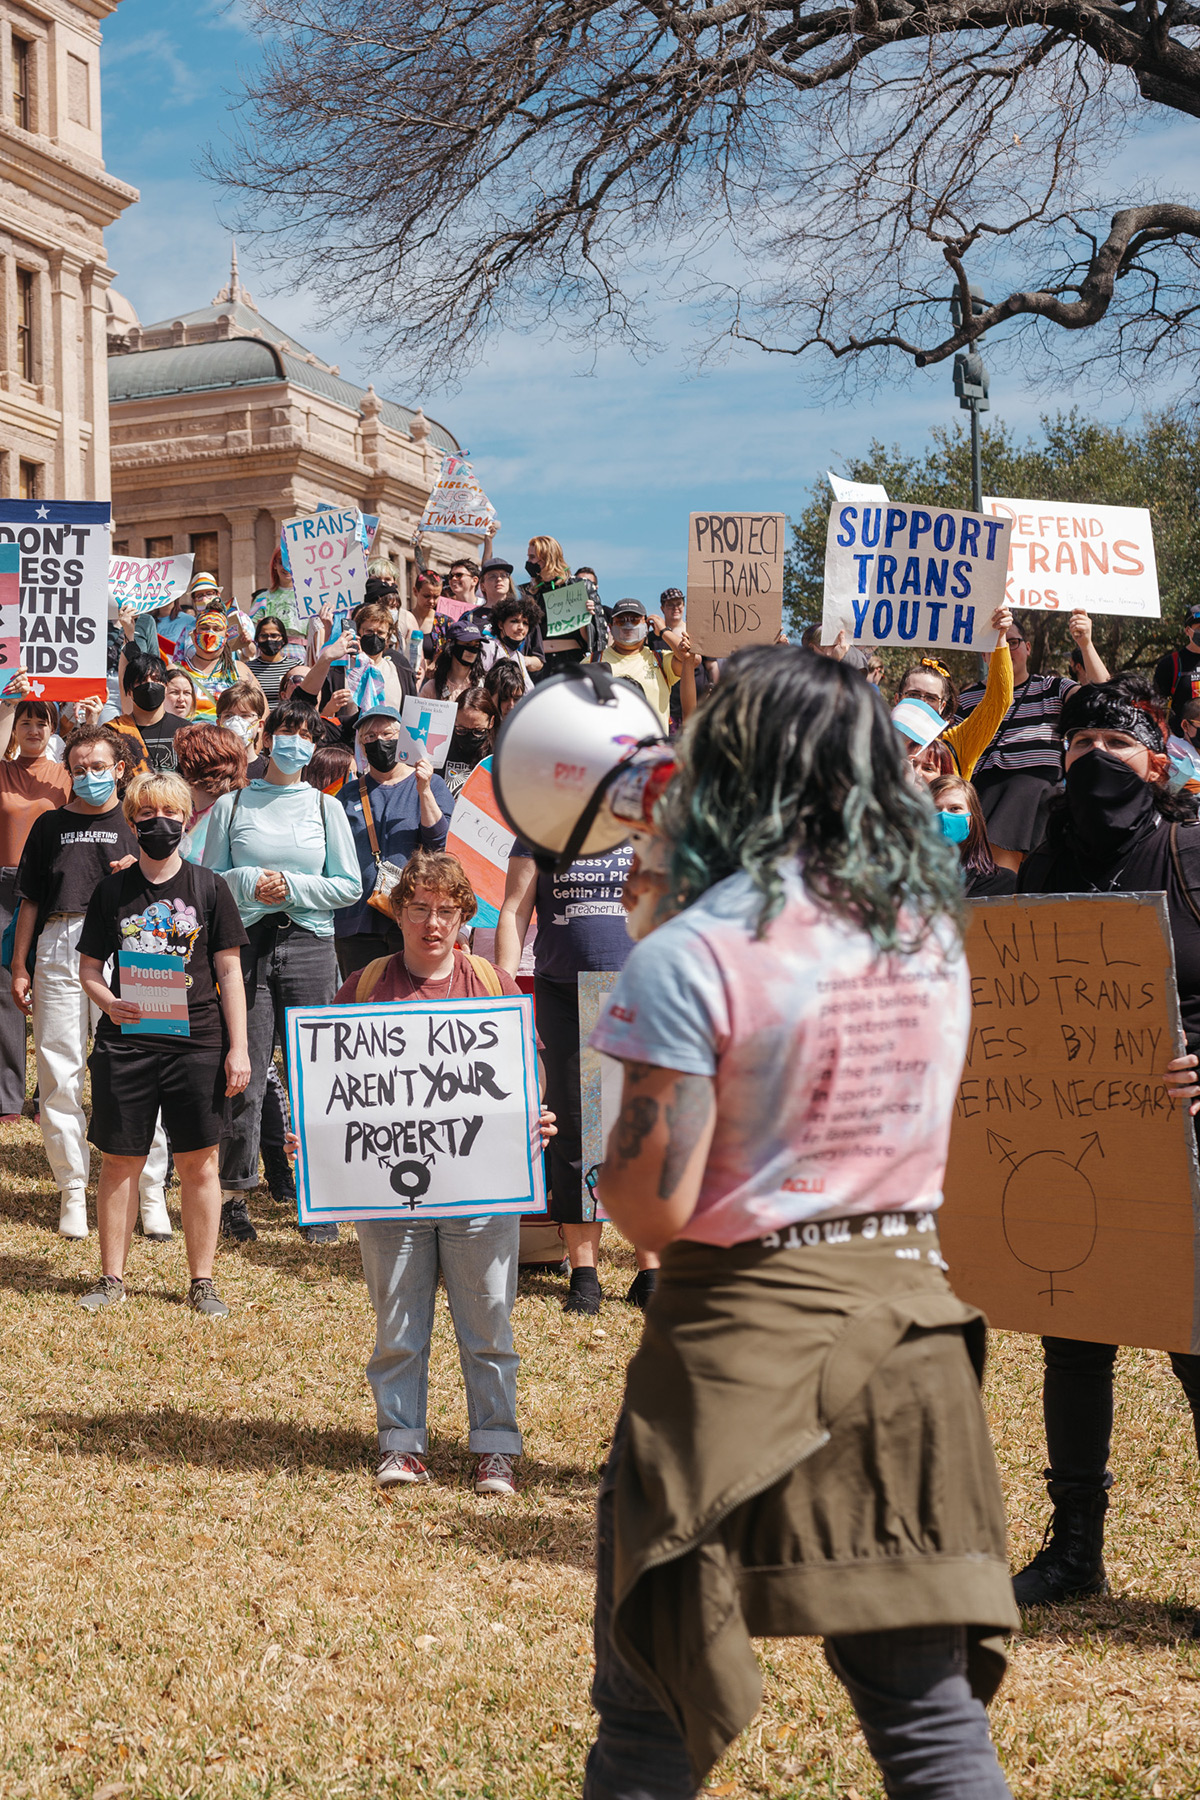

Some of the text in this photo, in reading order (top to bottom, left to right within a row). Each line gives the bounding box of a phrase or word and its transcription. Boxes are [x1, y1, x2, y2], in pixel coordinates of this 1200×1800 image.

[435, 490, 489, 506] NOT
[287, 512, 356, 541] TRANS
[424, 511, 490, 528] INVASION
[836, 506, 1004, 561] SUPPORT
[991, 503, 1104, 538] DEFEND
[304, 538, 348, 564] JOY
[695, 516, 785, 563] PROTECT
[21, 557, 84, 587] ESS
[1007, 540, 1145, 576] TRANS
[314, 565, 343, 589] IS
[703, 560, 772, 597] TRANS
[853, 553, 973, 599] TRANS
[303, 590, 361, 615] REAL
[712, 600, 761, 633] KIDS
[20, 616, 97, 645] RANS
[547, 612, 590, 634] TOXIC
[851, 599, 975, 644] YOUTH
[20, 646, 79, 675] IDS
[60, 831, 75, 840] LIFE
[85, 830, 118, 839] FLEETING
[553, 872, 605, 883] Lesson
[572, 858, 613, 868] essy
[553, 887, 597, 899] Gettin'
[601, 887, 610, 898] it
[983, 920, 1141, 968] WILL
[131, 965, 173, 980] Protect
[135, 983, 169, 997] Trans
[970, 972, 1154, 1015] END TRANS
[137, 1001, 172, 1012] Youth
[818, 993, 930, 1019] people belong
[300, 1016, 499, 1062] TRANS KIDS
[965, 1025, 1162, 1075] VES BY ANY
[326, 1060, 512, 1115] AREN'T YOUR
[955, 1075, 1176, 1122] EANS NECESSARY
[345, 1115, 484, 1164] PROPERTY
[780, 1177, 825, 1193] ACLU
